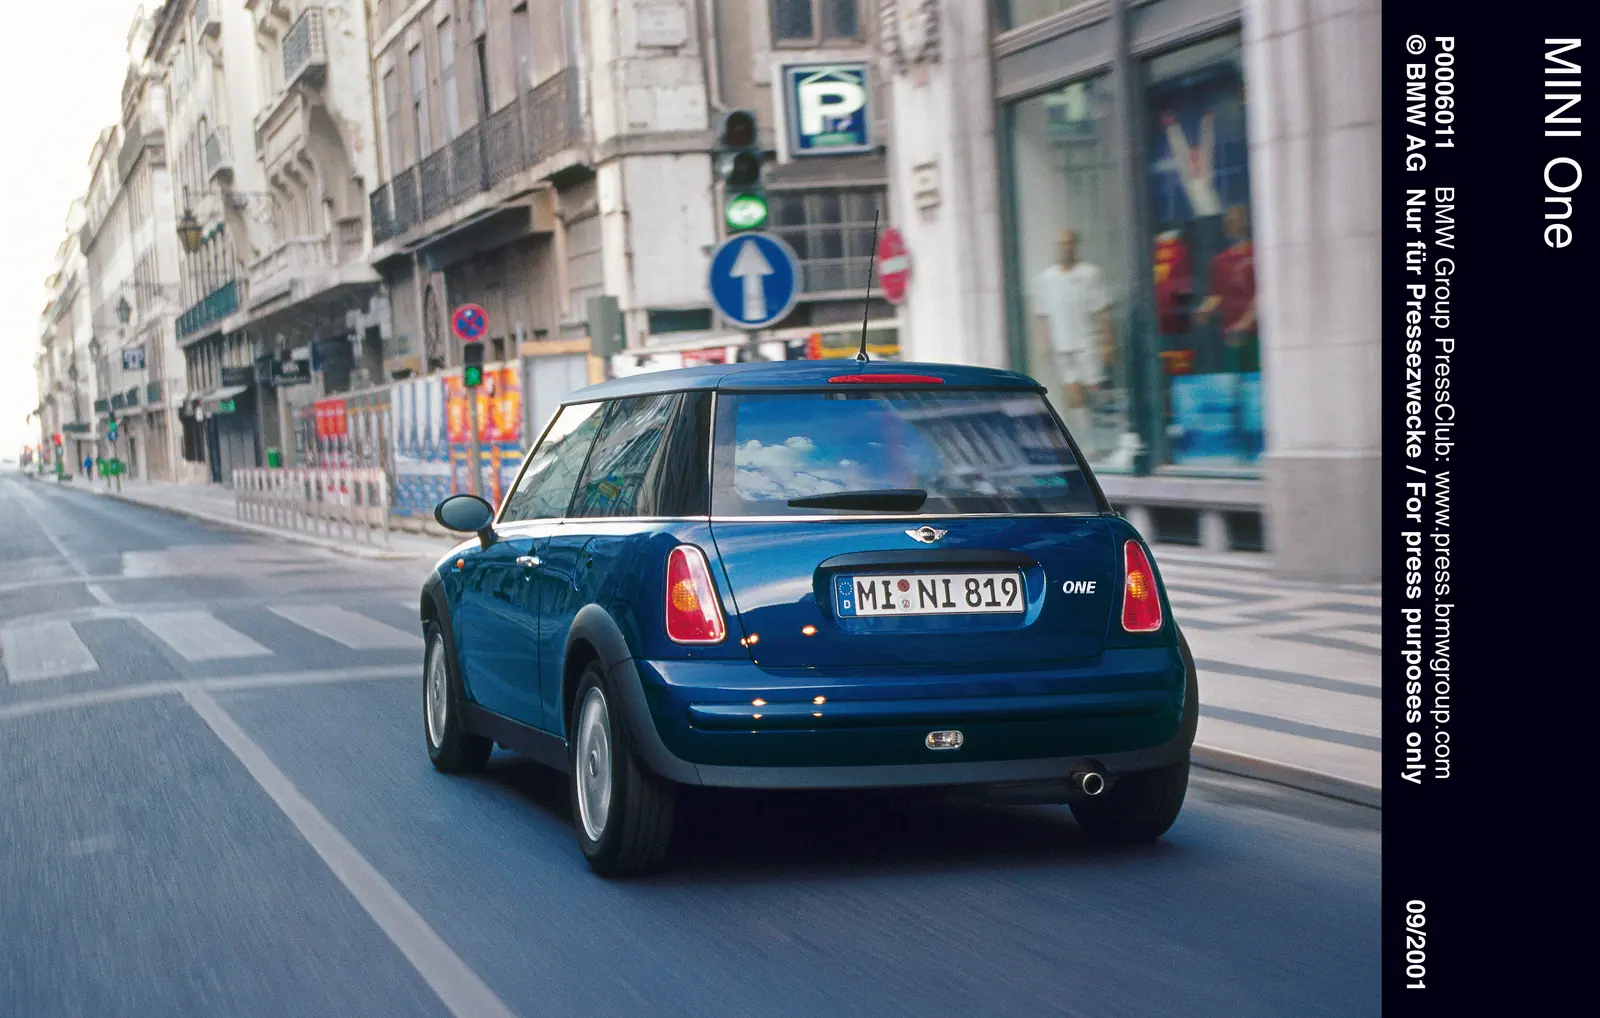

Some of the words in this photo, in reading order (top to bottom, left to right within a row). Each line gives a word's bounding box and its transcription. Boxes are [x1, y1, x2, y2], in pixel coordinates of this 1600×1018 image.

[798, 81, 867, 135] P
[856, 580, 896, 610] MI
[917, 579, 956, 608] NI
[964, 578, 1018, 608] 819
[1062, 580, 1097, 595] ONE
[843, 599, 851, 609] D
